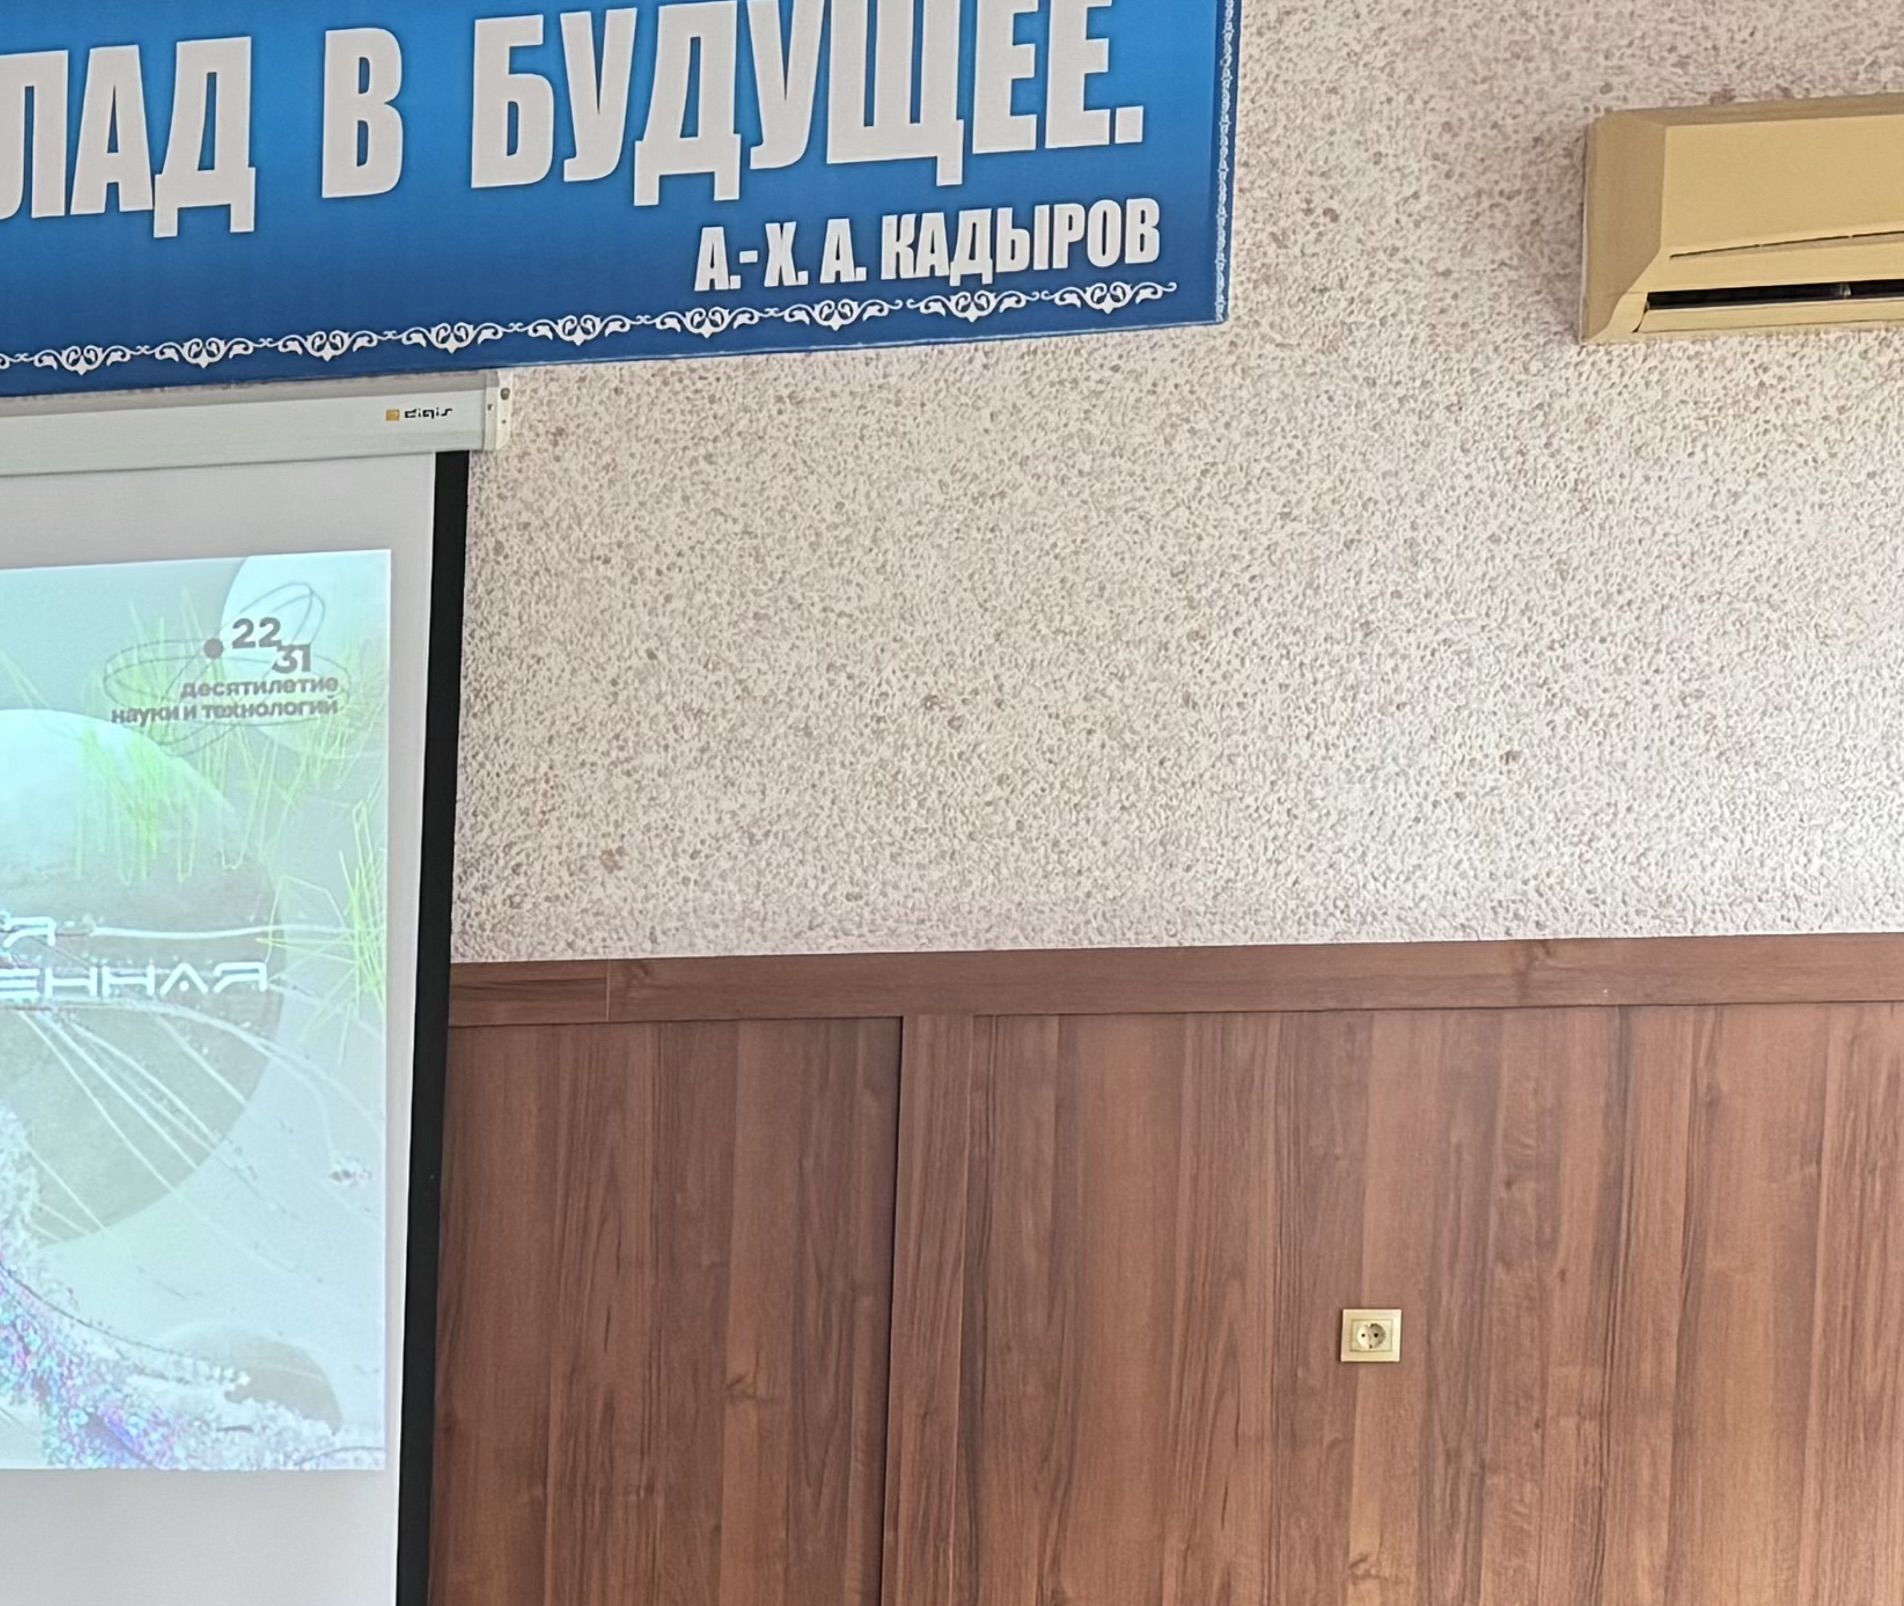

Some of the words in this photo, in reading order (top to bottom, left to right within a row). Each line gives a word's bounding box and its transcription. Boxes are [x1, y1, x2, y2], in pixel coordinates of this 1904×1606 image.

[321, 27, 403, 199] В
[471, 0, 1144, 207] БУДУЩЕЕ.
[819, 218, 867, 284] А.
[880, 197, 1160, 287] КАДЫРОВ
[231, 616, 282, 650] 22
[271, 643, 311, 674] 31
[180, 676, 339, 699] десятилетие
[111, 708, 179, 728] науки
[183, 705, 197, 720] и
[201, 695, 339, 719] технологий
